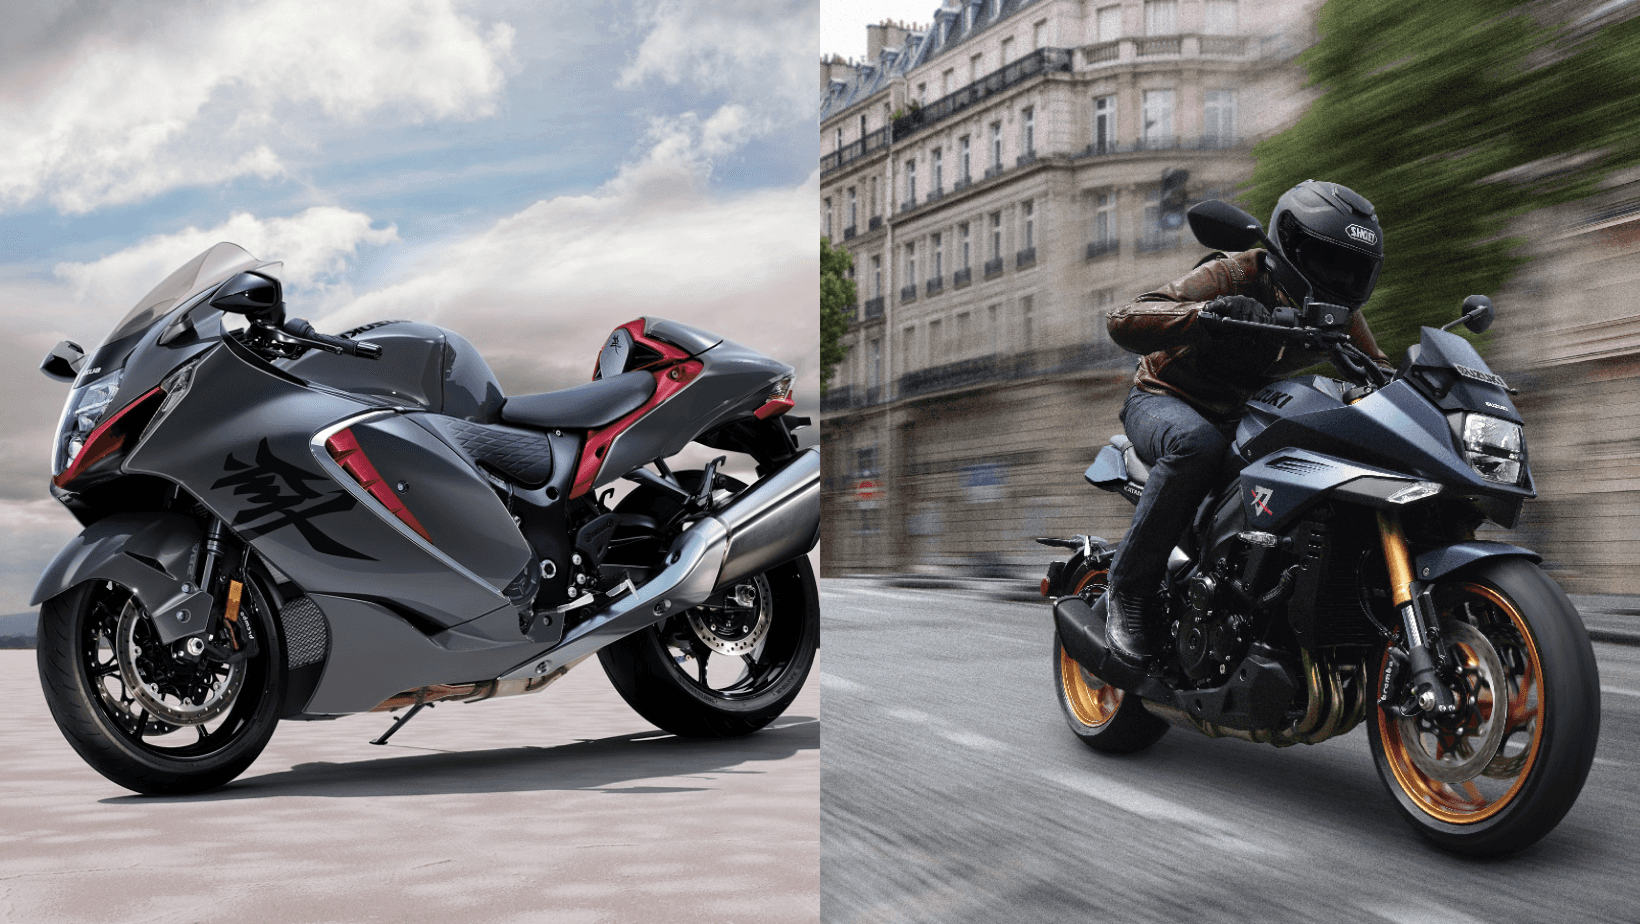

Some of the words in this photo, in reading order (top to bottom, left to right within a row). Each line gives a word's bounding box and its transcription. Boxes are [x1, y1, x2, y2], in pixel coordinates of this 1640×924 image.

[1350, 226, 1376, 244] SHOEI
[1457, 364, 1506, 388] SUZUKI
[1252, 389, 1294, 410] ZUKI
[1380, 661, 1393, 701] brembo
